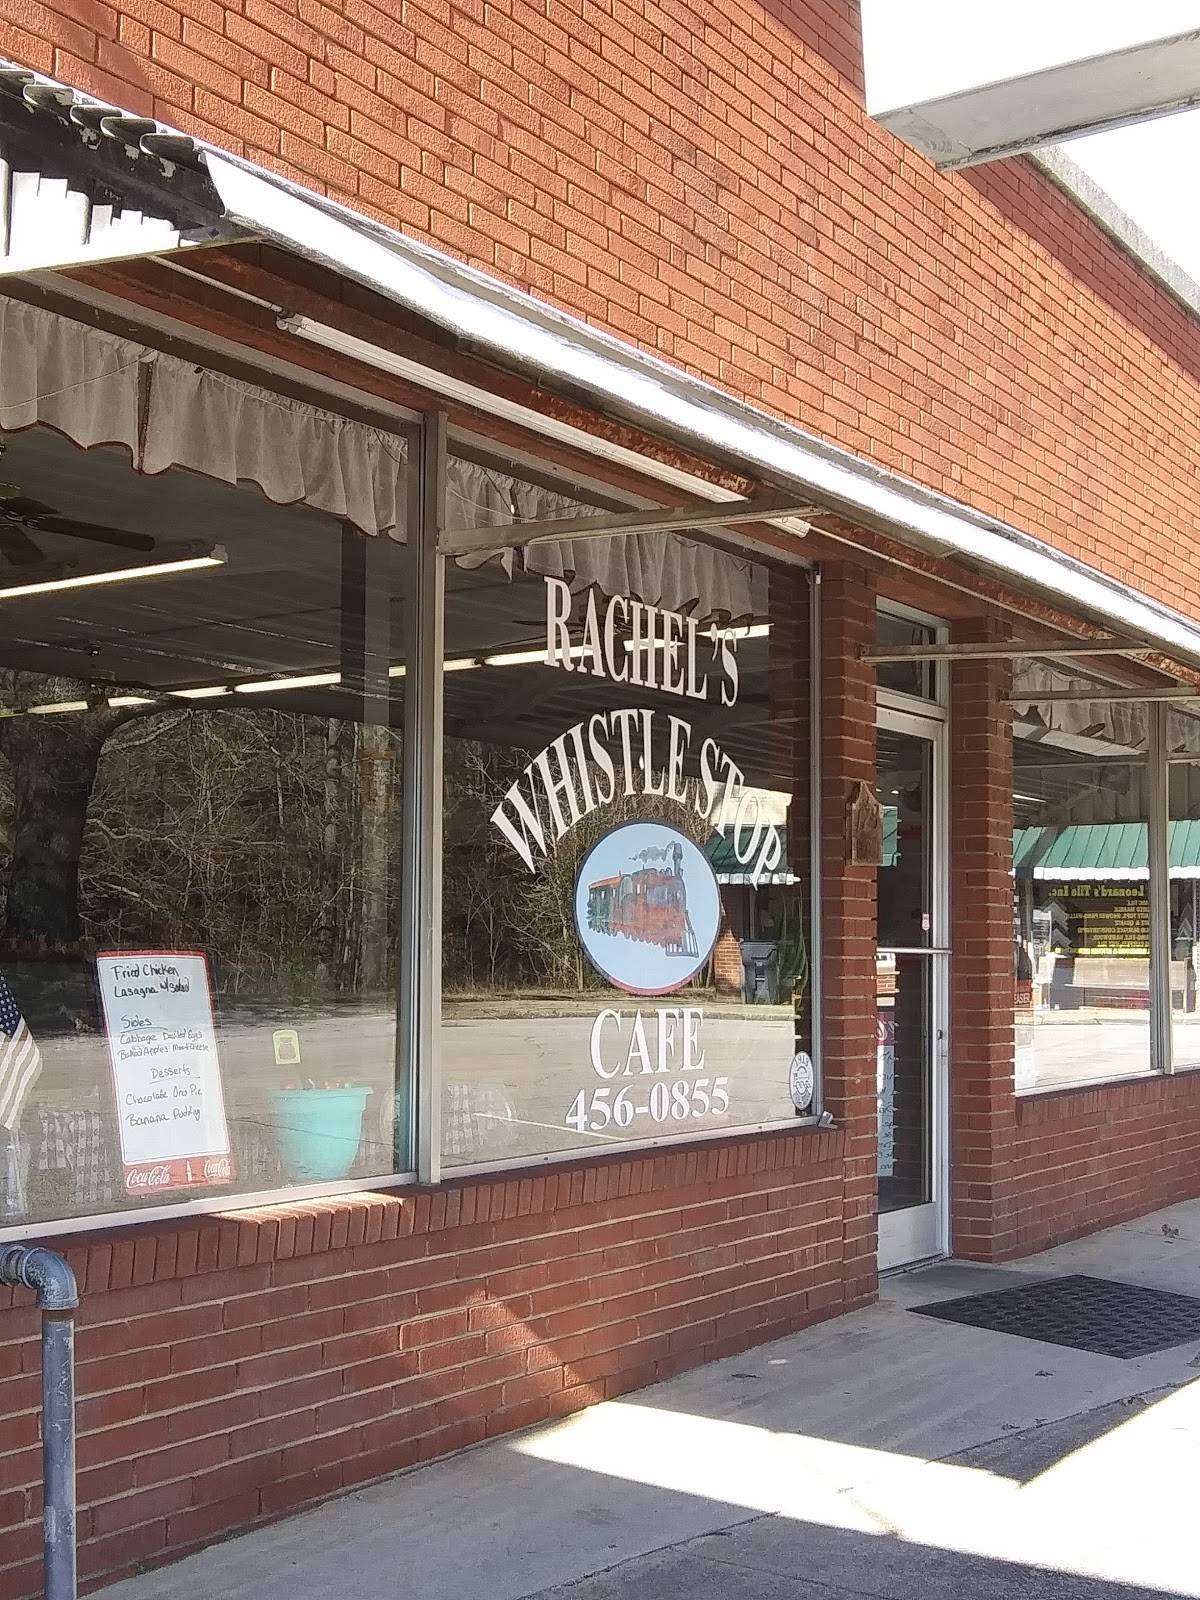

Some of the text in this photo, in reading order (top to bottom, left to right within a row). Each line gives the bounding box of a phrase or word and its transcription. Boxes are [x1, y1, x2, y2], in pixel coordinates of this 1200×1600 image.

[543, 575, 740, 709] RACHEL'S
[490, 707, 782, 892] WHISTLE STOP
[110, 963, 180, 981] Fried Chicken
[114, 985, 159, 999] Lasagna
[120, 1014, 153, 1029] Sides
[120, 1033, 158, 1045] Cabbage
[589, 1007, 706, 1079] CAFE
[150, 1063, 191, 1080] Desserts
[564, 1076, 730, 1134] 456-0855
[125, 1112, 170, 1127] Banana
